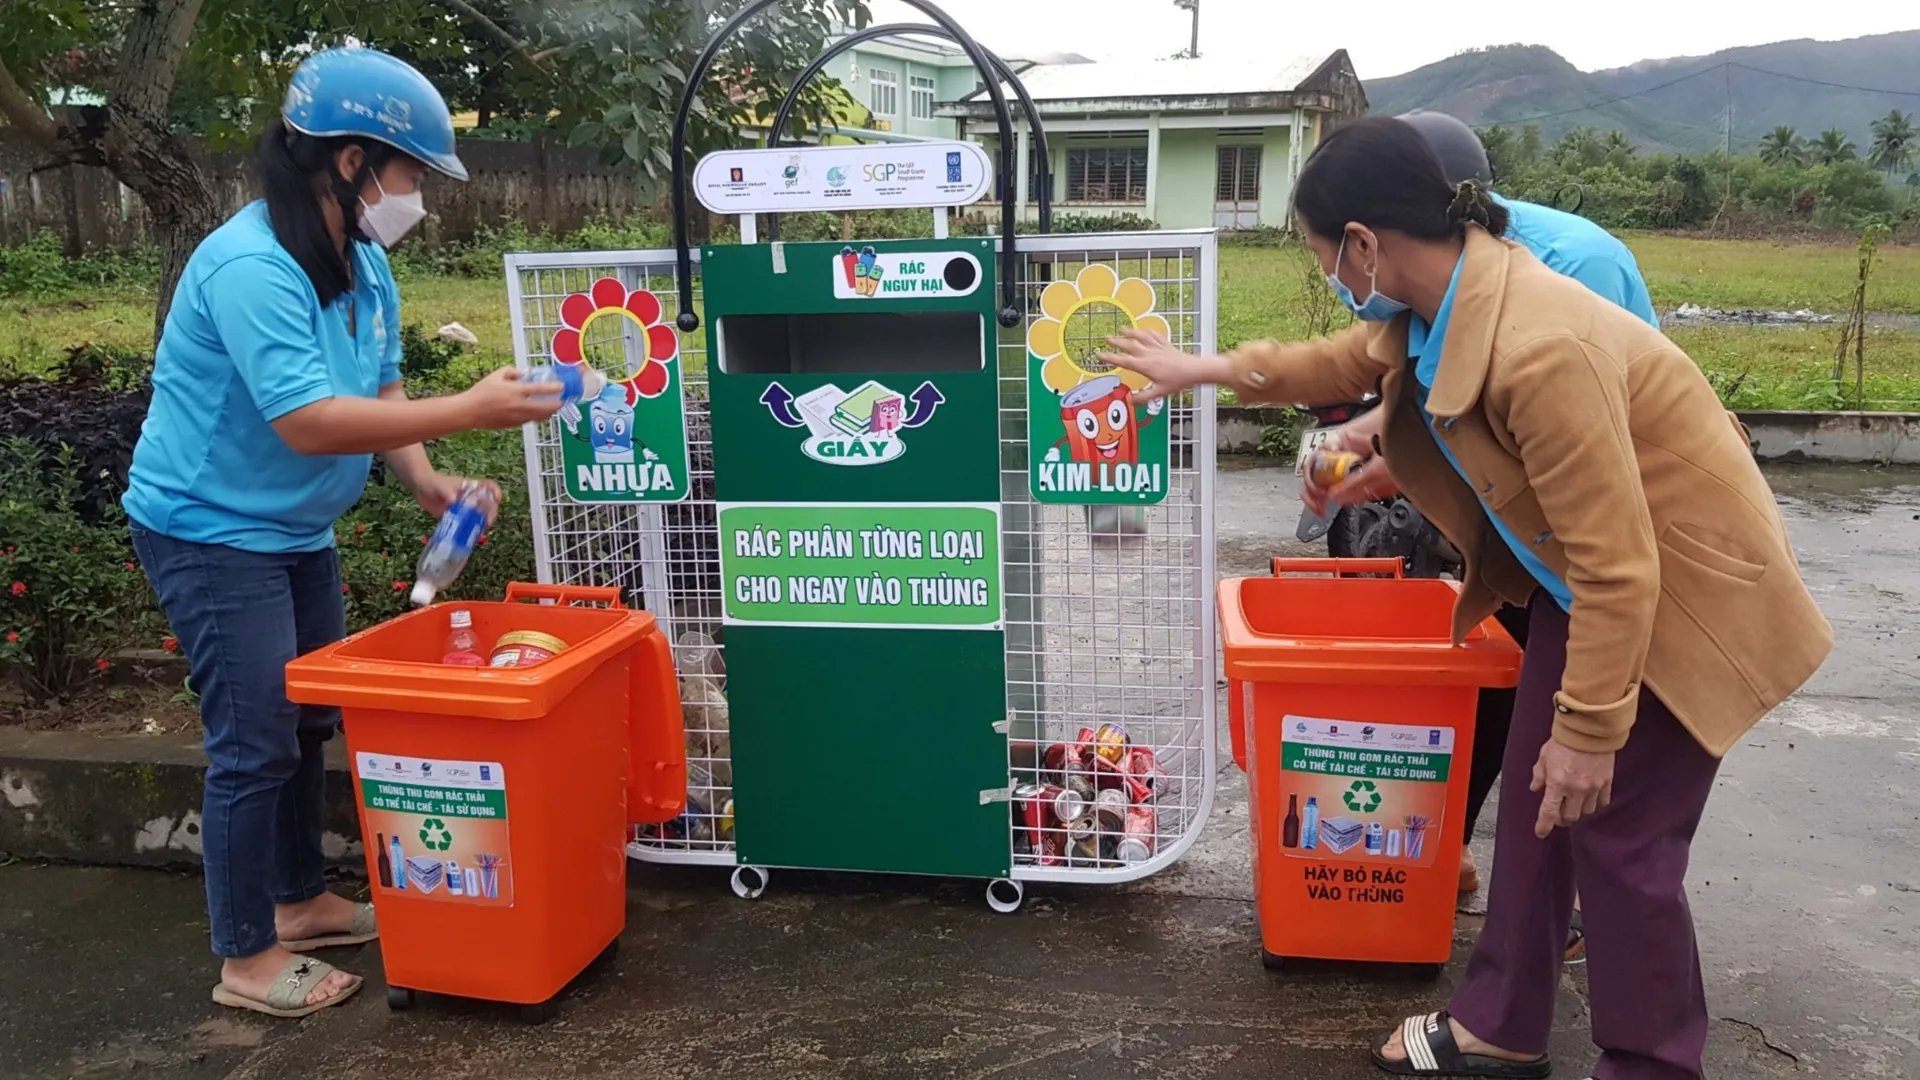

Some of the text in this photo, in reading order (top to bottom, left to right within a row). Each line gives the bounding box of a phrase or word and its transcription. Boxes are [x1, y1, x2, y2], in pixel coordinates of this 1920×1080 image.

[863, 163, 896, 182] SGP
[785, 178, 799, 188] gef
[899, 260, 925, 274] RÁC
[883, 279, 943, 294] NGUY HẠI
[577, 461, 675, 498] NHỰA
[1039, 463, 1160, 499] KIM LOẠI
[735, 524, 983, 565] RÁC PHÂN TỪNG LOẠI
[736, 571, 988, 606] CHO NGAY VÀO THÙNG
[1304, 747, 1429, 765] THÙNG THU GOM RÁC THẢI
[1293, 760, 1306, 769] CÓ
[1309, 759, 1327, 770] THỂ
[1329, 762, 1344, 773] TÁI
[1347, 763, 1366, 775] CHẾ
[1376, 766, 1391, 777] TÁI
[1394, 766, 1408, 777] SỬ
[1409, 769, 1437, 780] DỤNG
[378, 784, 485, 802] THÙNG THU GOM RÁC THẢI
[373, 796, 384, 807] CÓ
[402, 799, 415, 810] TÁI
[416, 799, 433, 812] CHẾ
[441, 803, 454, 814] TÁI
[470, 806, 495, 818] DỤNG
[1304, 864, 1407, 884] HÃY BỎ RÁC
[1307, 882, 1405, 903] VÀO THÙNG
